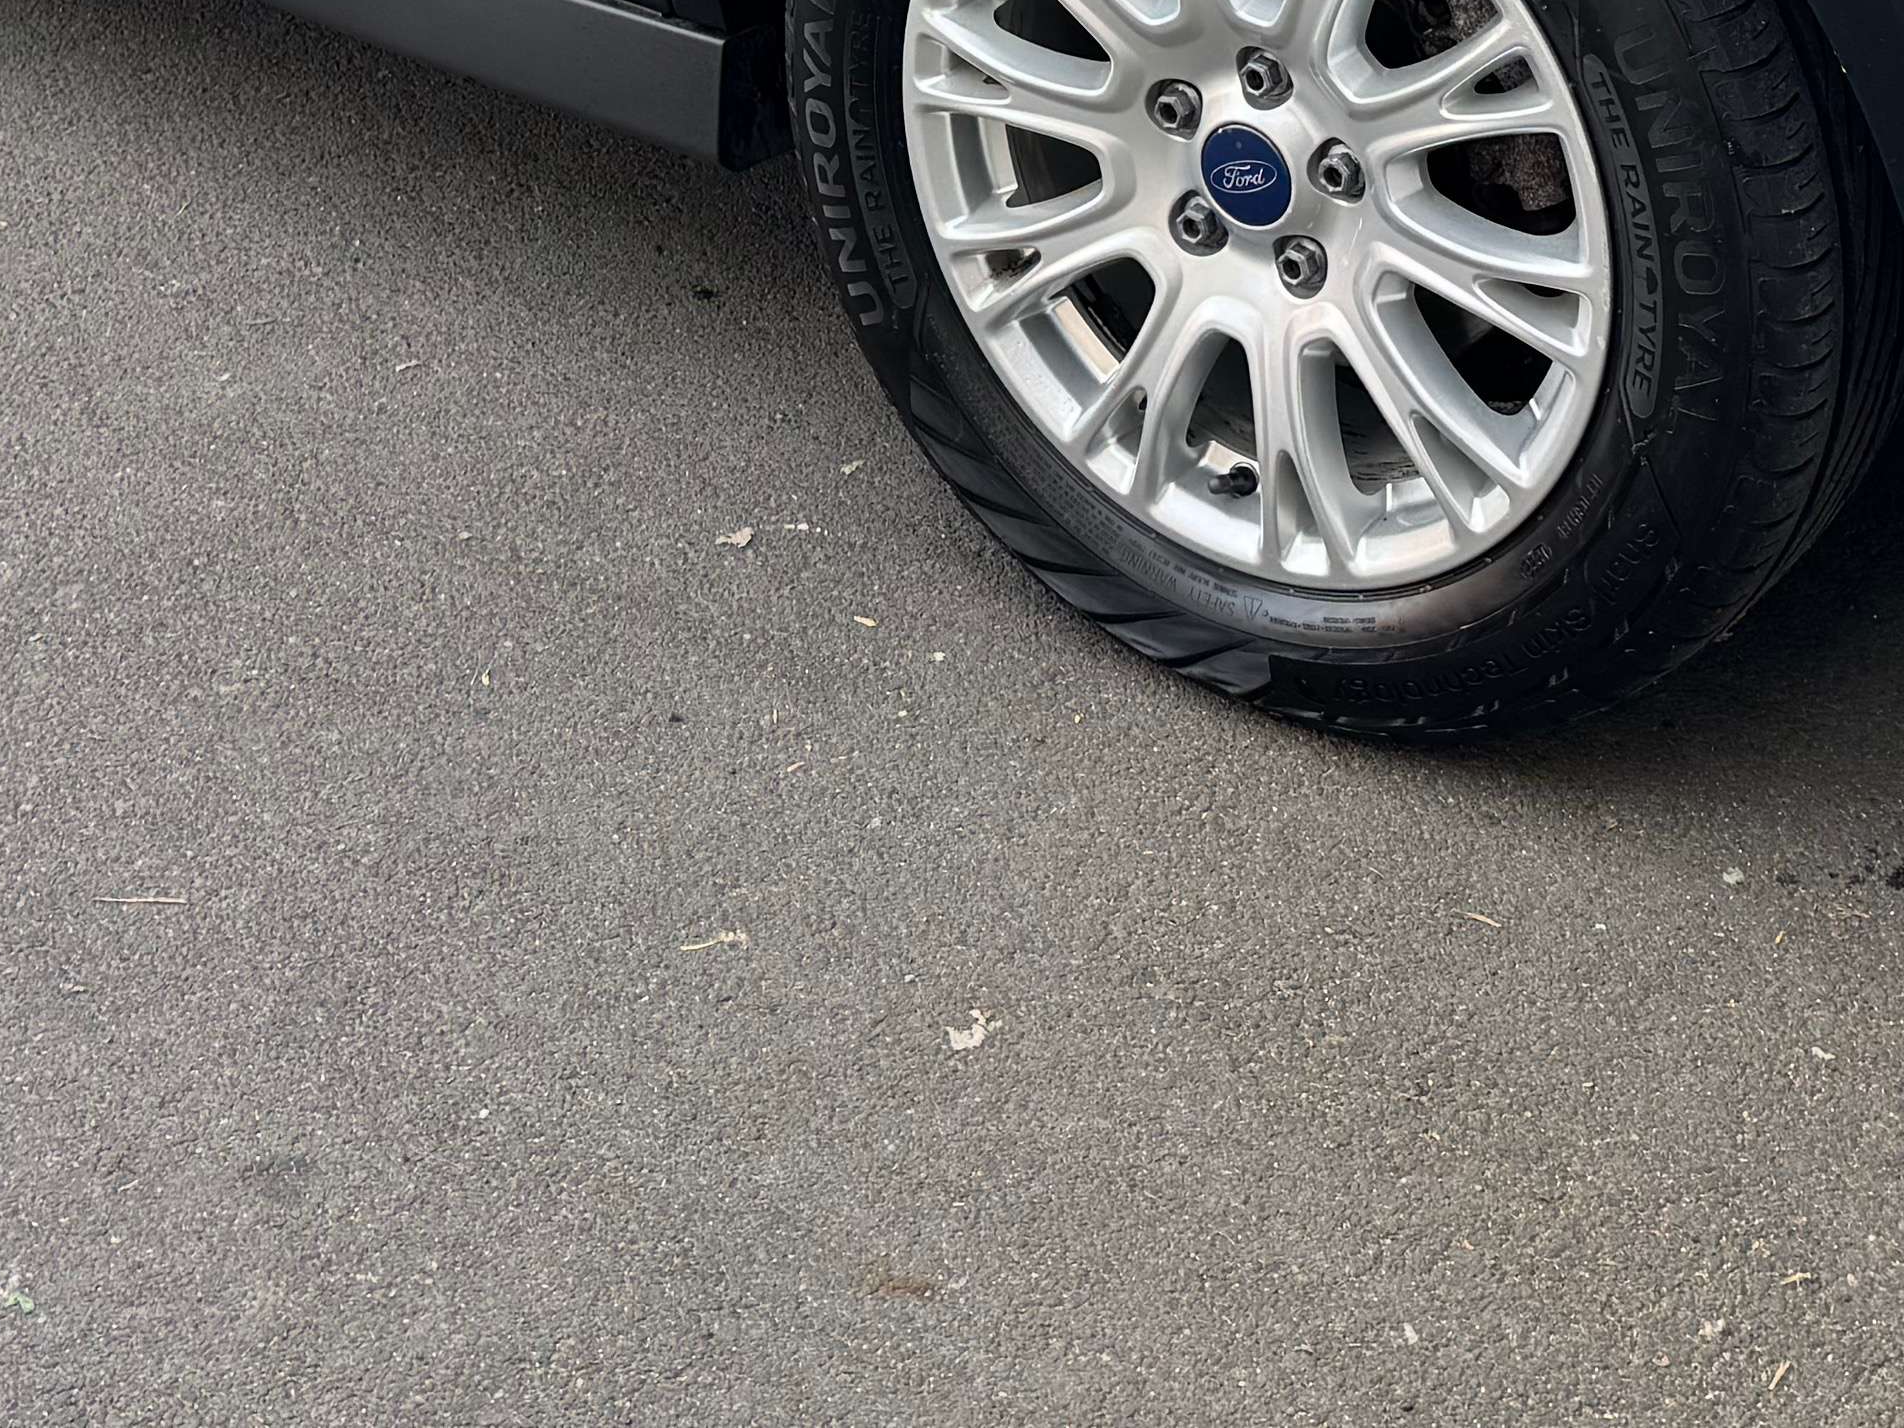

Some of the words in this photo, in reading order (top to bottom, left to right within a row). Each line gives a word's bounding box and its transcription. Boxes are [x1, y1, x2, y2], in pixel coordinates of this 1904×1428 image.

[1591, 70, 1631, 150] THE
[1223, 164, 1265, 189] Ford
[1619, 162, 1658, 264] RAIN
[1613, 24, 1726, 436] UNIROYAL
[1632, 298, 1658, 397] TYRE
